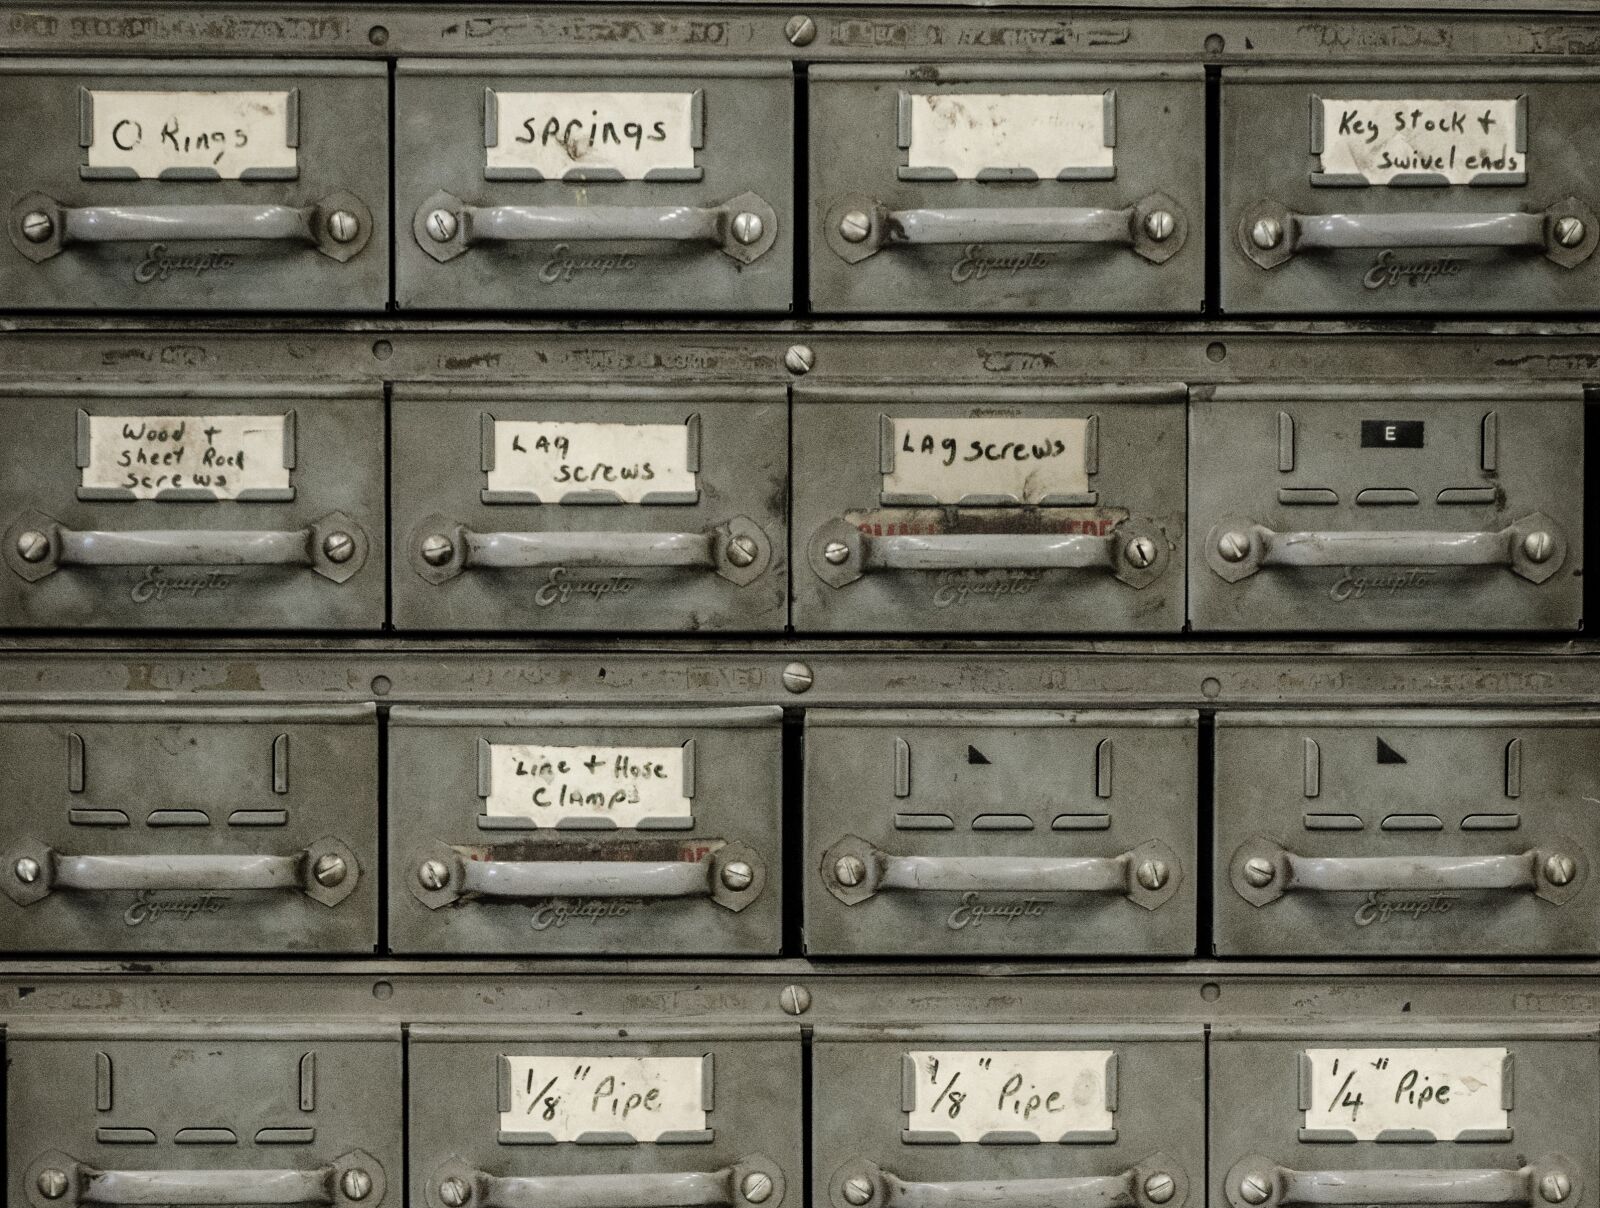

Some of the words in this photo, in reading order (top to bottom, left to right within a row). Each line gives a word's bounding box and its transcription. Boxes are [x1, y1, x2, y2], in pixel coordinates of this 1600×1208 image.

[112, 120, 142, 150] O
[1338, 110, 1379, 143] Key
[1465, 144, 1518, 171] ends
[122, 422, 185, 442] Wood
[1385, 425, 1397, 441] E
[614, 755, 668, 780] Hose
[592, 1075, 663, 1121] Pipe
[999, 1073, 1065, 1120] Pipe
[1395, 1070, 1450, 1110] Pipe
